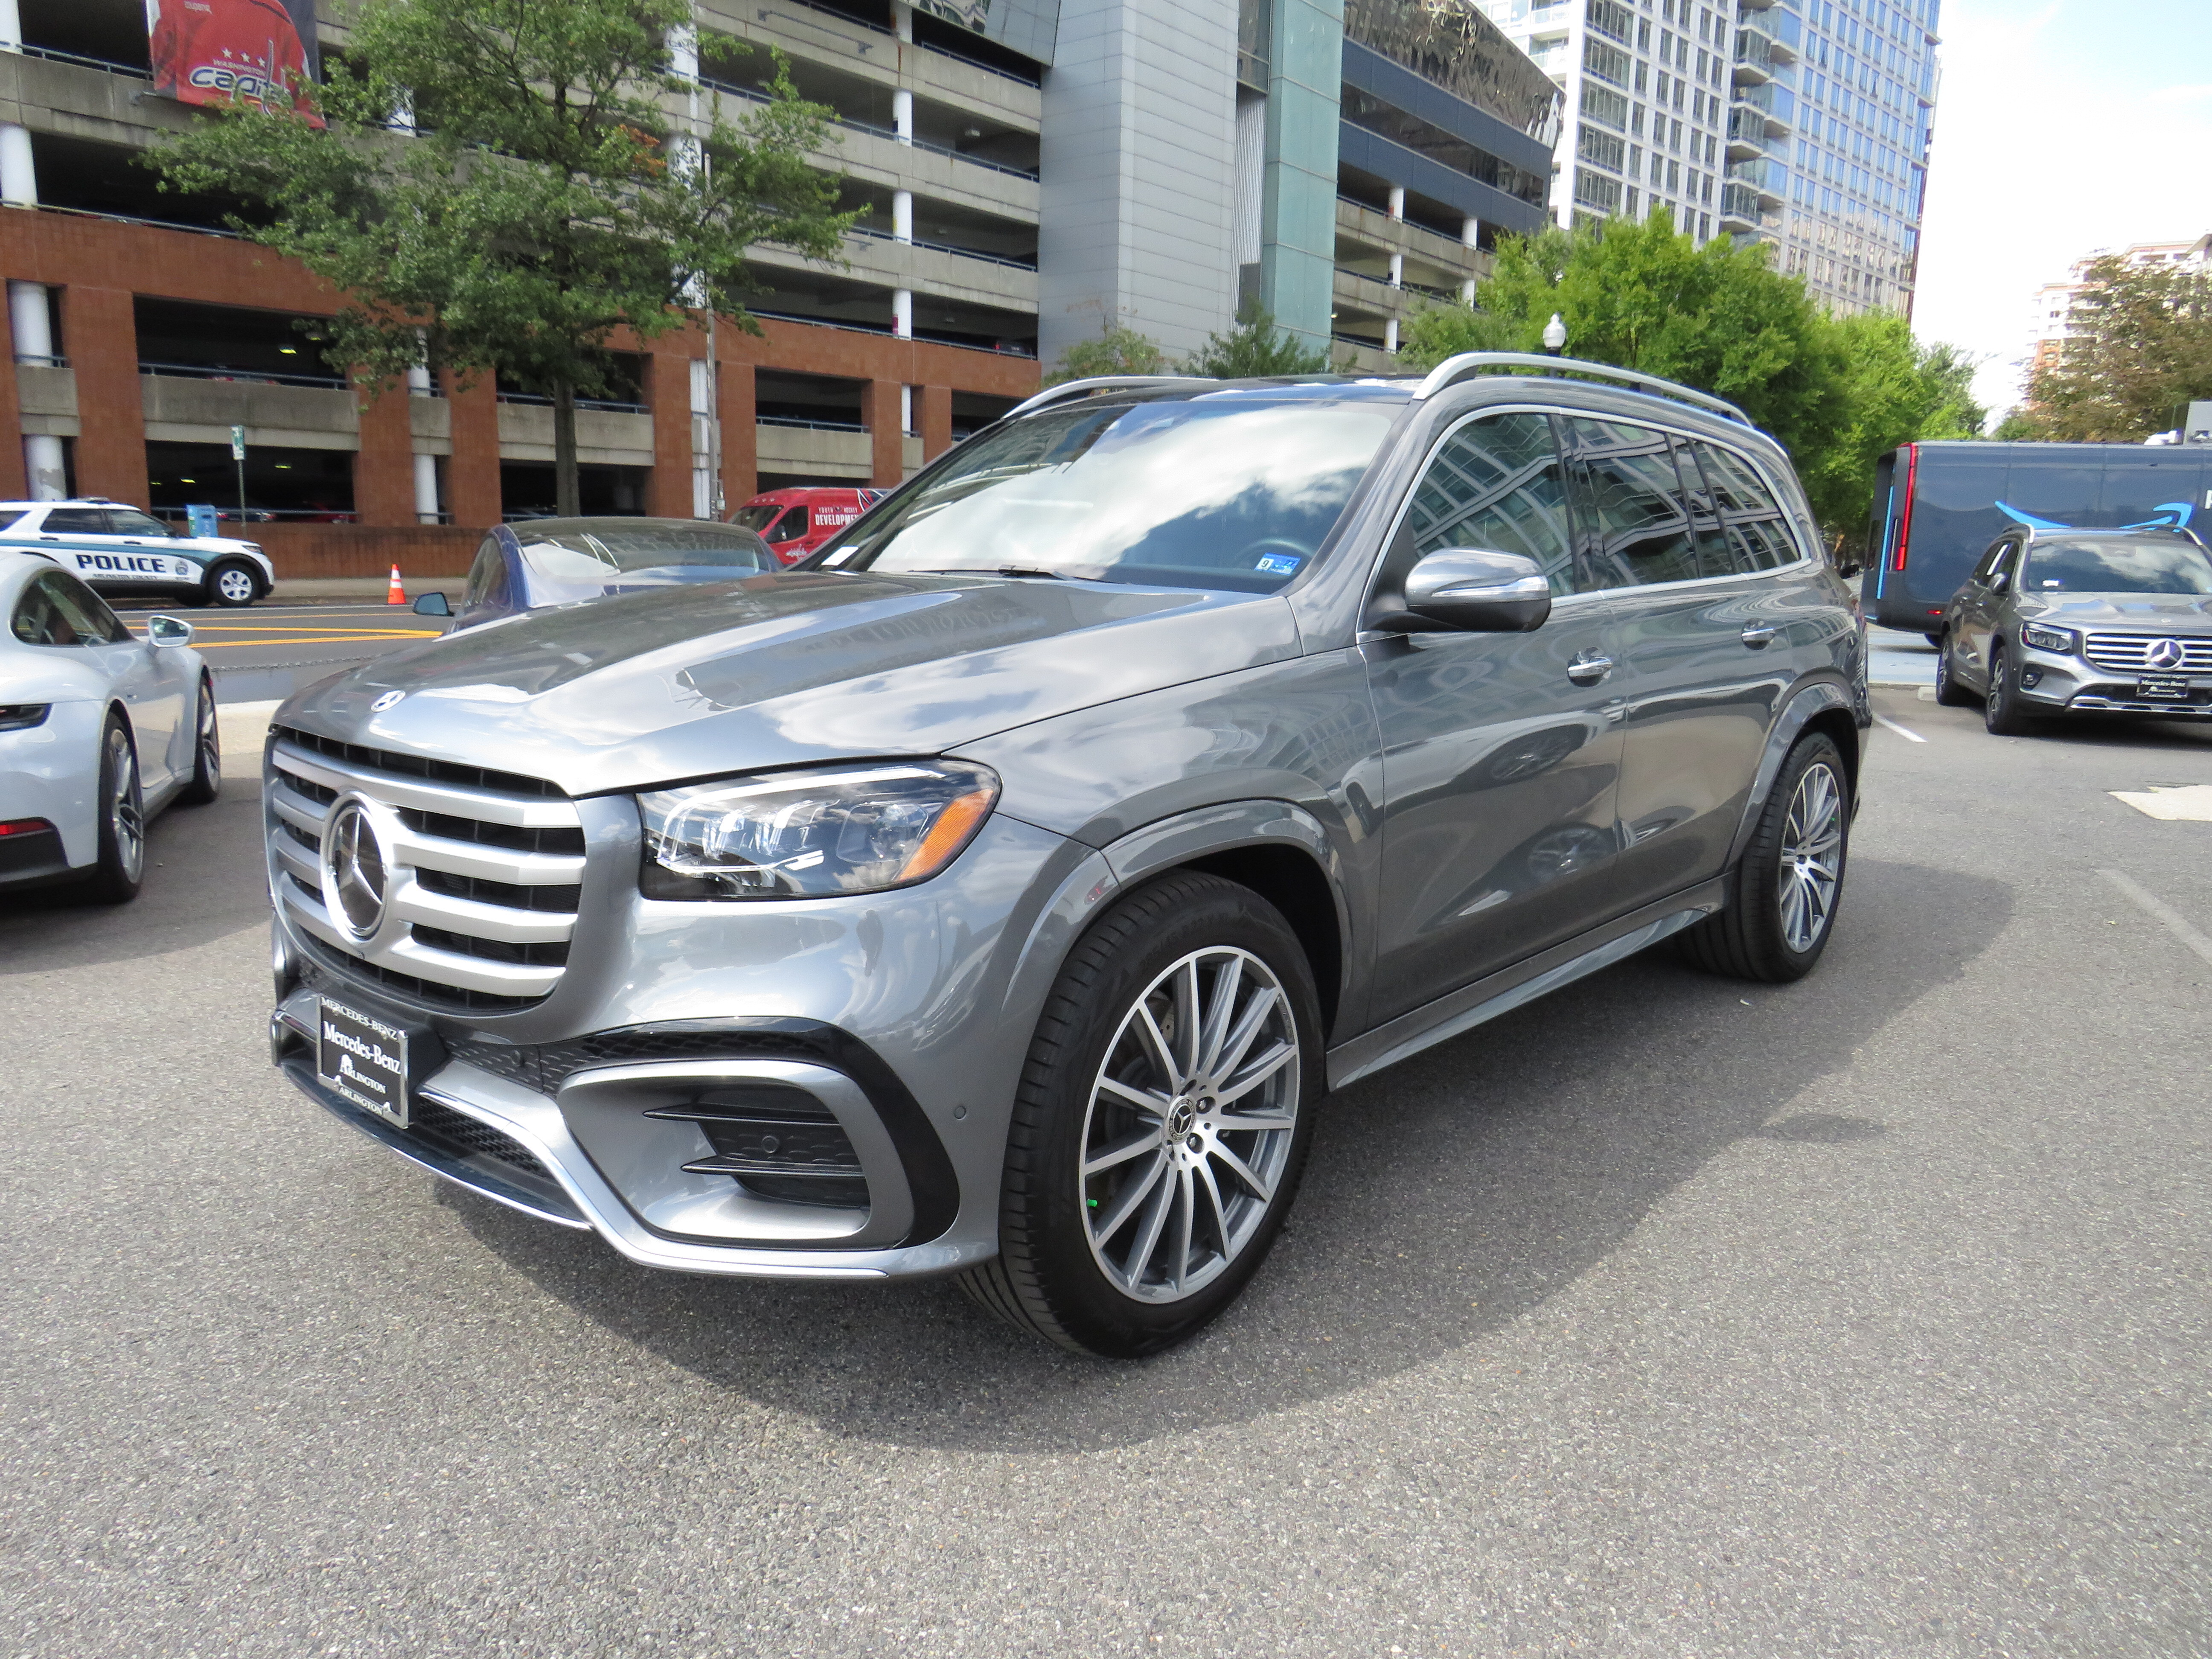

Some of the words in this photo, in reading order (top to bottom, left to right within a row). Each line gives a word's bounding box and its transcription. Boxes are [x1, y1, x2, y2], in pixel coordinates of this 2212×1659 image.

[815, 514, 859, 526] DEVELOPME
[75, 554, 167, 573] POLICE
[2141, 679, 2186, 687] Mercedes-Benz
[321, 996, 398, 1040] MERCEDES-BENZ
[323, 1021, 402, 1075] Mercedes-Benz
[339, 1062, 387, 1094] ARLINGTON
[339, 1087, 383, 1115] ARLINGTON
